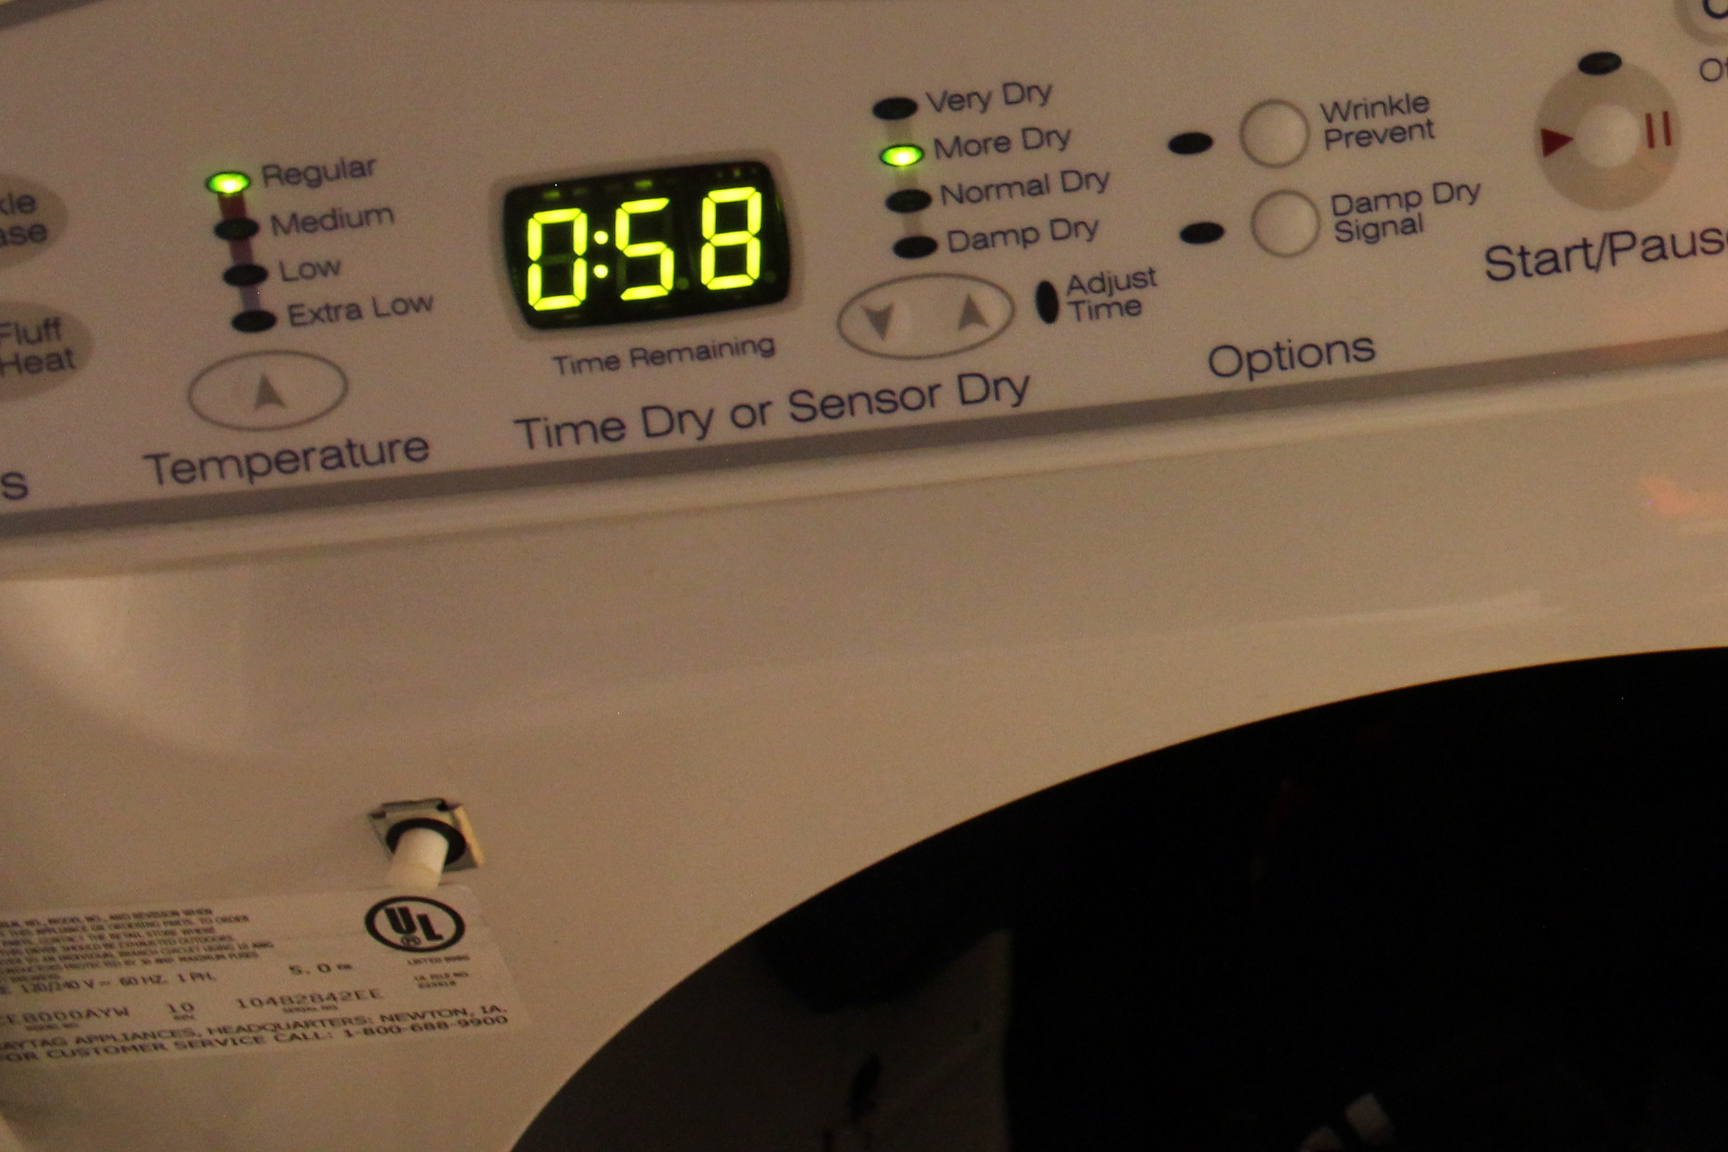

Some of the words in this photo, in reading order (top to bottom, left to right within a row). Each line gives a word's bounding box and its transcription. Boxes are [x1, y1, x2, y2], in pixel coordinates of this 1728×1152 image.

[925, 86, 993, 114] Very
[1002, 81, 1054, 106] Dry
[1319, 93, 1430, 125] Wrinkle
[933, 134, 1012, 162] More
[1021, 126, 1073, 152] Dry
[1323, 116, 1437, 152] Prevent
[262, 156, 377, 189] Regular
[941, 173, 1050, 208] Normal
[1060, 169, 1112, 195] Dry
[1331, 186, 1424, 218] Damp
[1432, 179, 1482, 207] Dry
[271, 204, 395, 237] Medium
[947, 225, 1040, 255] Damp
[1050, 217, 1100, 244] Dry
[1334, 212, 1425, 247] Signal
[527, 186, 763, 311] 0:58
[279, 260, 342, 284] Low
[1066, 266, 1159, 299] Adjust
[288, 301, 364, 329] Extra
[373, 294, 435, 319] Low
[1067, 296, 1144, 323] Time
[0, 347, 77, 377] Heat
[552, 352, 621, 377] Time
[630, 336, 776, 368] Remaining
[1207, 333, 1377, 382] Options
[514, 413, 627, 451] Time
[641, 405, 715, 441] Dry
[730, 398, 773, 431] or
[788, 381, 943, 424] Sensor
[957, 372, 1031, 408] Dry
[143, 435, 431, 486] Temperature
[384, 906, 444, 941] UL
[46, 1041, 168, 1060] CUSTOMER
[174, 1034, 265, 1050] SERVICE
